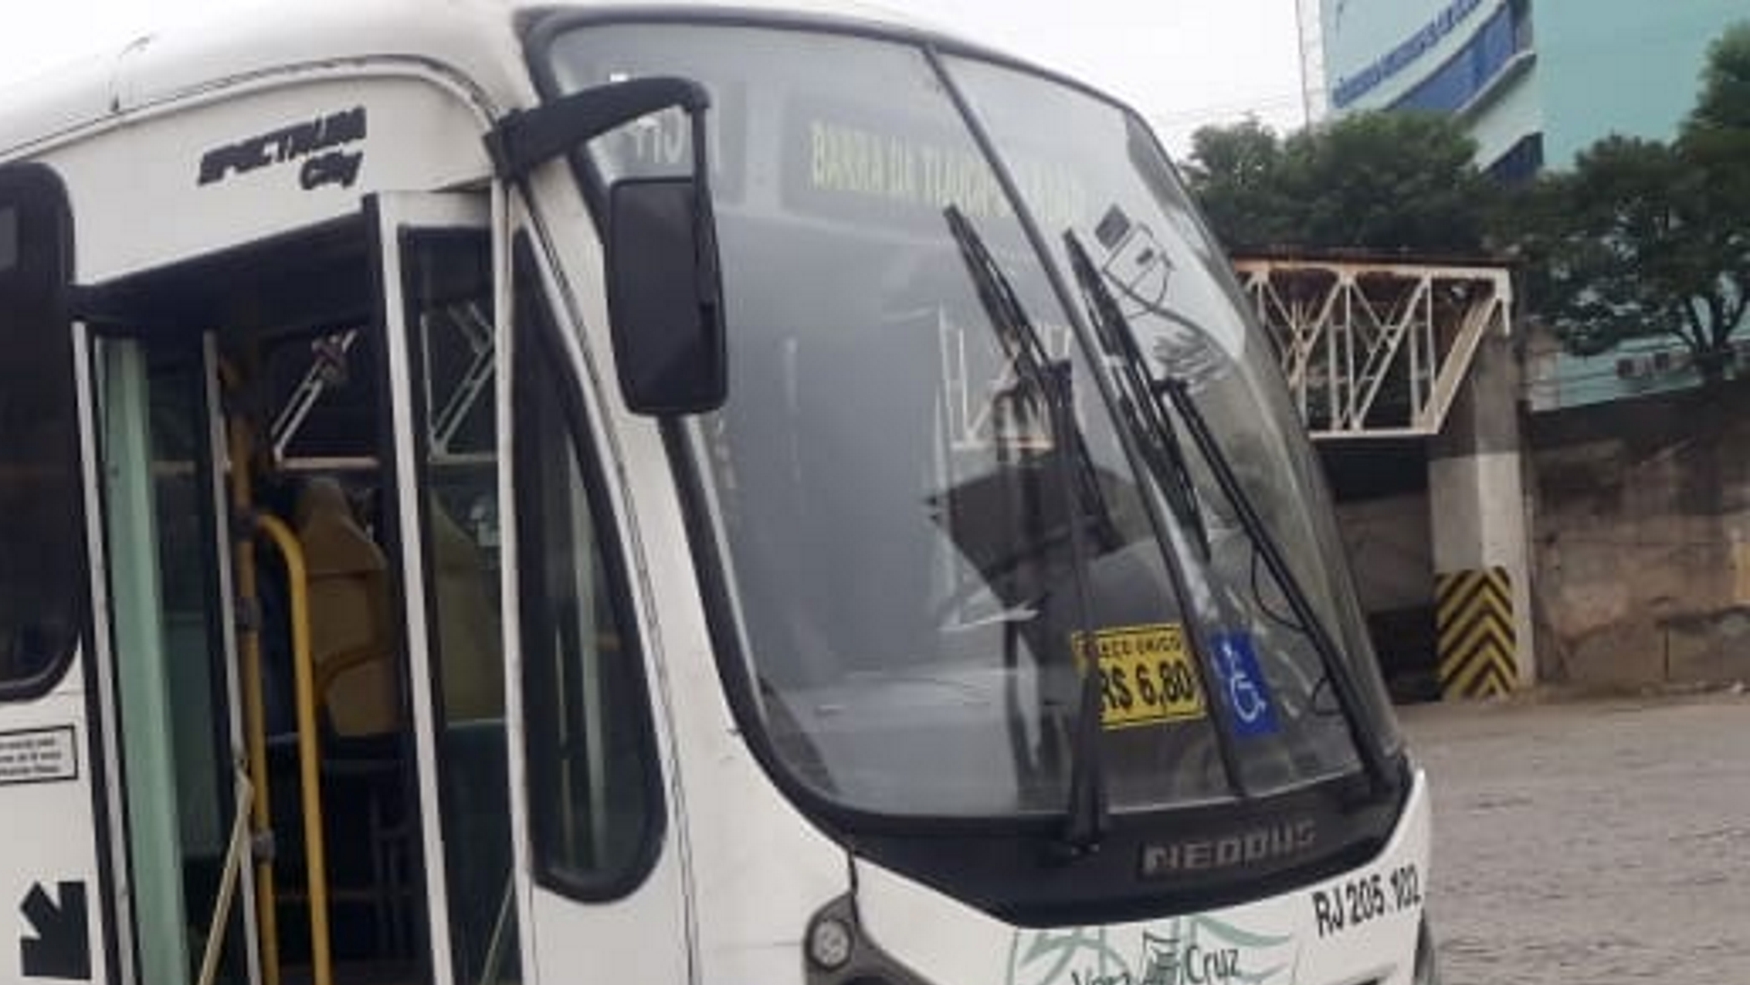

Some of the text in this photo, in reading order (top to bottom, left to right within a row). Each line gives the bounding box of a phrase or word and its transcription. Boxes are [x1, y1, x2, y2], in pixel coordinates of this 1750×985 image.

[1135, 659, 1196, 706] 6,80
[1312, 887, 1344, 938] RJ
[1185, 945, 1242, 985] Cruz
